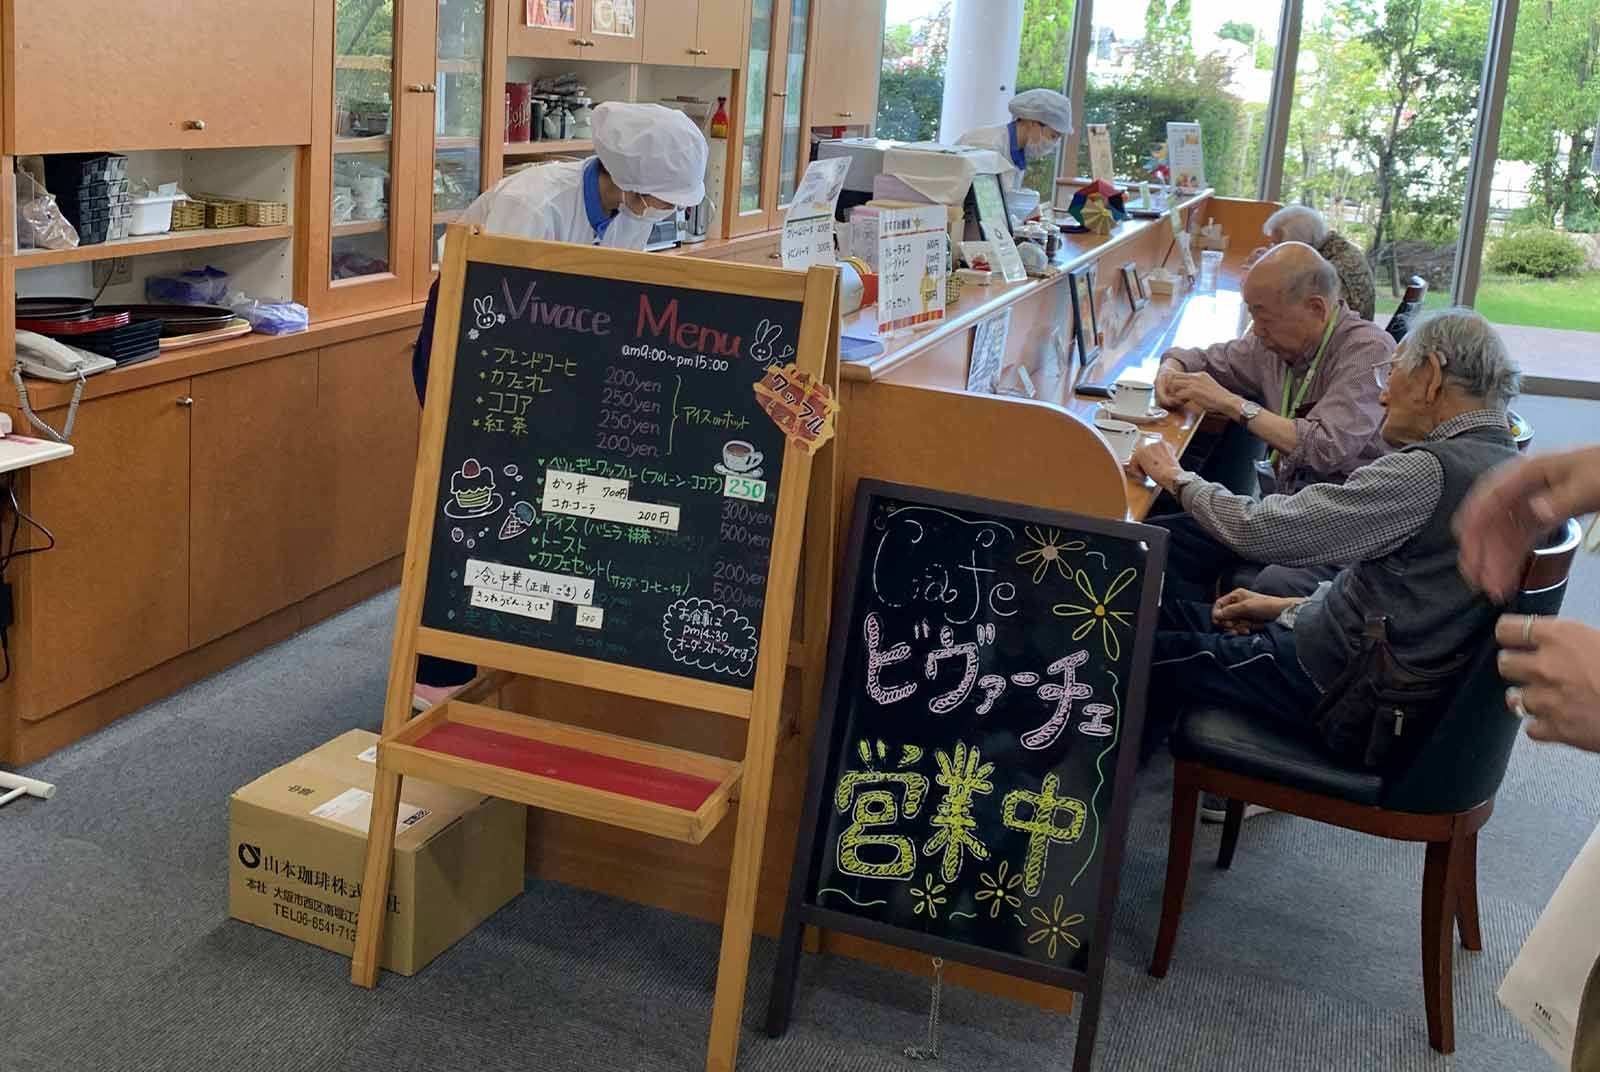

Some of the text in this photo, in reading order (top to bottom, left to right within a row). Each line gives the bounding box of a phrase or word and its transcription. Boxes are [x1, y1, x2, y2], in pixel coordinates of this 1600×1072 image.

[501, 276, 742, 358] Vivace Menu
[491, 368, 662, 414] カフェオレ 250yen
[604, 365, 663, 394] 200yen
[483, 413, 661, 459] 紅茶 200yen
[487, 391, 533, 415] ココア
[597, 408, 662, 436] 250yen
[728, 477, 765, 500] 250
[541, 536, 588, 552] トースト
[543, 515, 577, 534] アイス
[719, 523, 771, 549] 500yen
[873, 519, 1019, 625] Cafe
[835, 738, 1089, 897] 営業中
